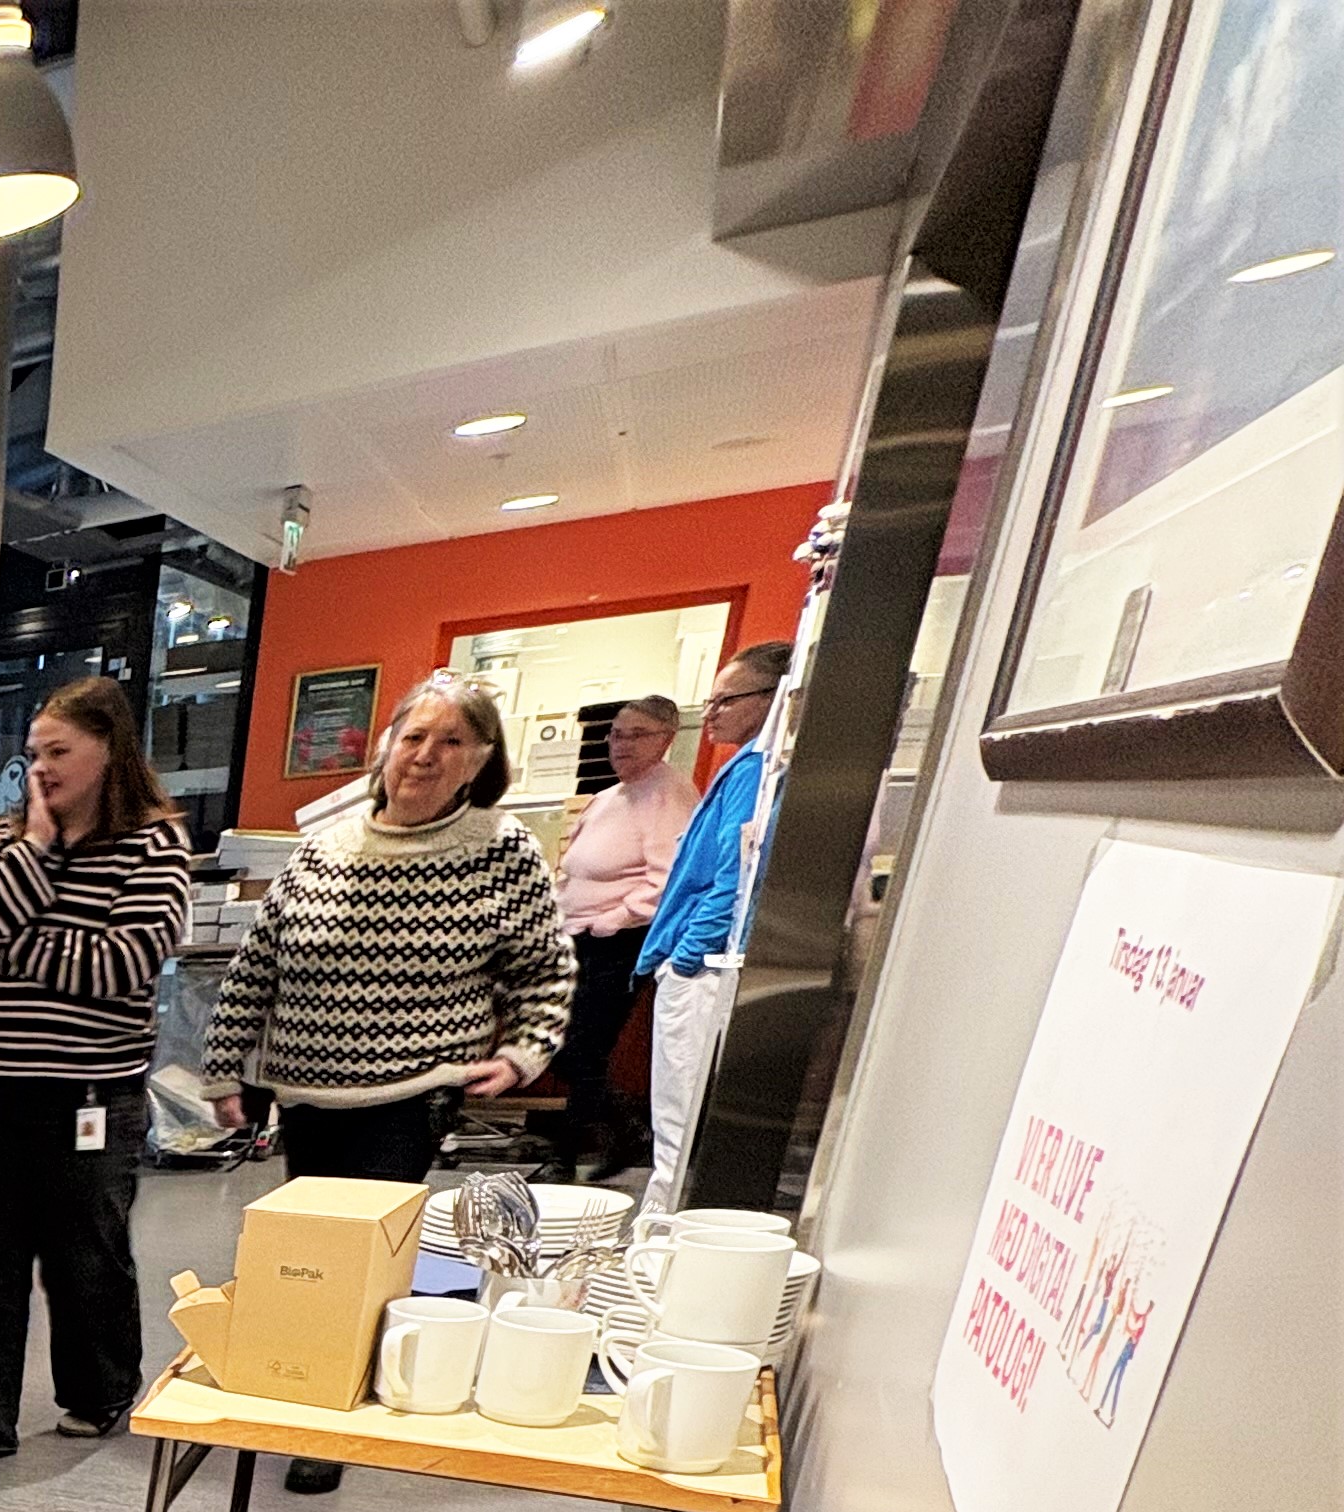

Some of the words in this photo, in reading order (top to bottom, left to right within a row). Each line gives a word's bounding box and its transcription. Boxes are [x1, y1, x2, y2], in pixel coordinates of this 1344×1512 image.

[1109, 926, 1154, 993] Tirsdag
[1160, 949, 1206, 1012] januar
[1050, 1135, 1105, 1224] LIVE
[986, 1199, 1029, 1273] MED
[1015, 1221, 1078, 1322] DIGITAL
[963, 1277, 1047, 1414] PATOLOGI!
